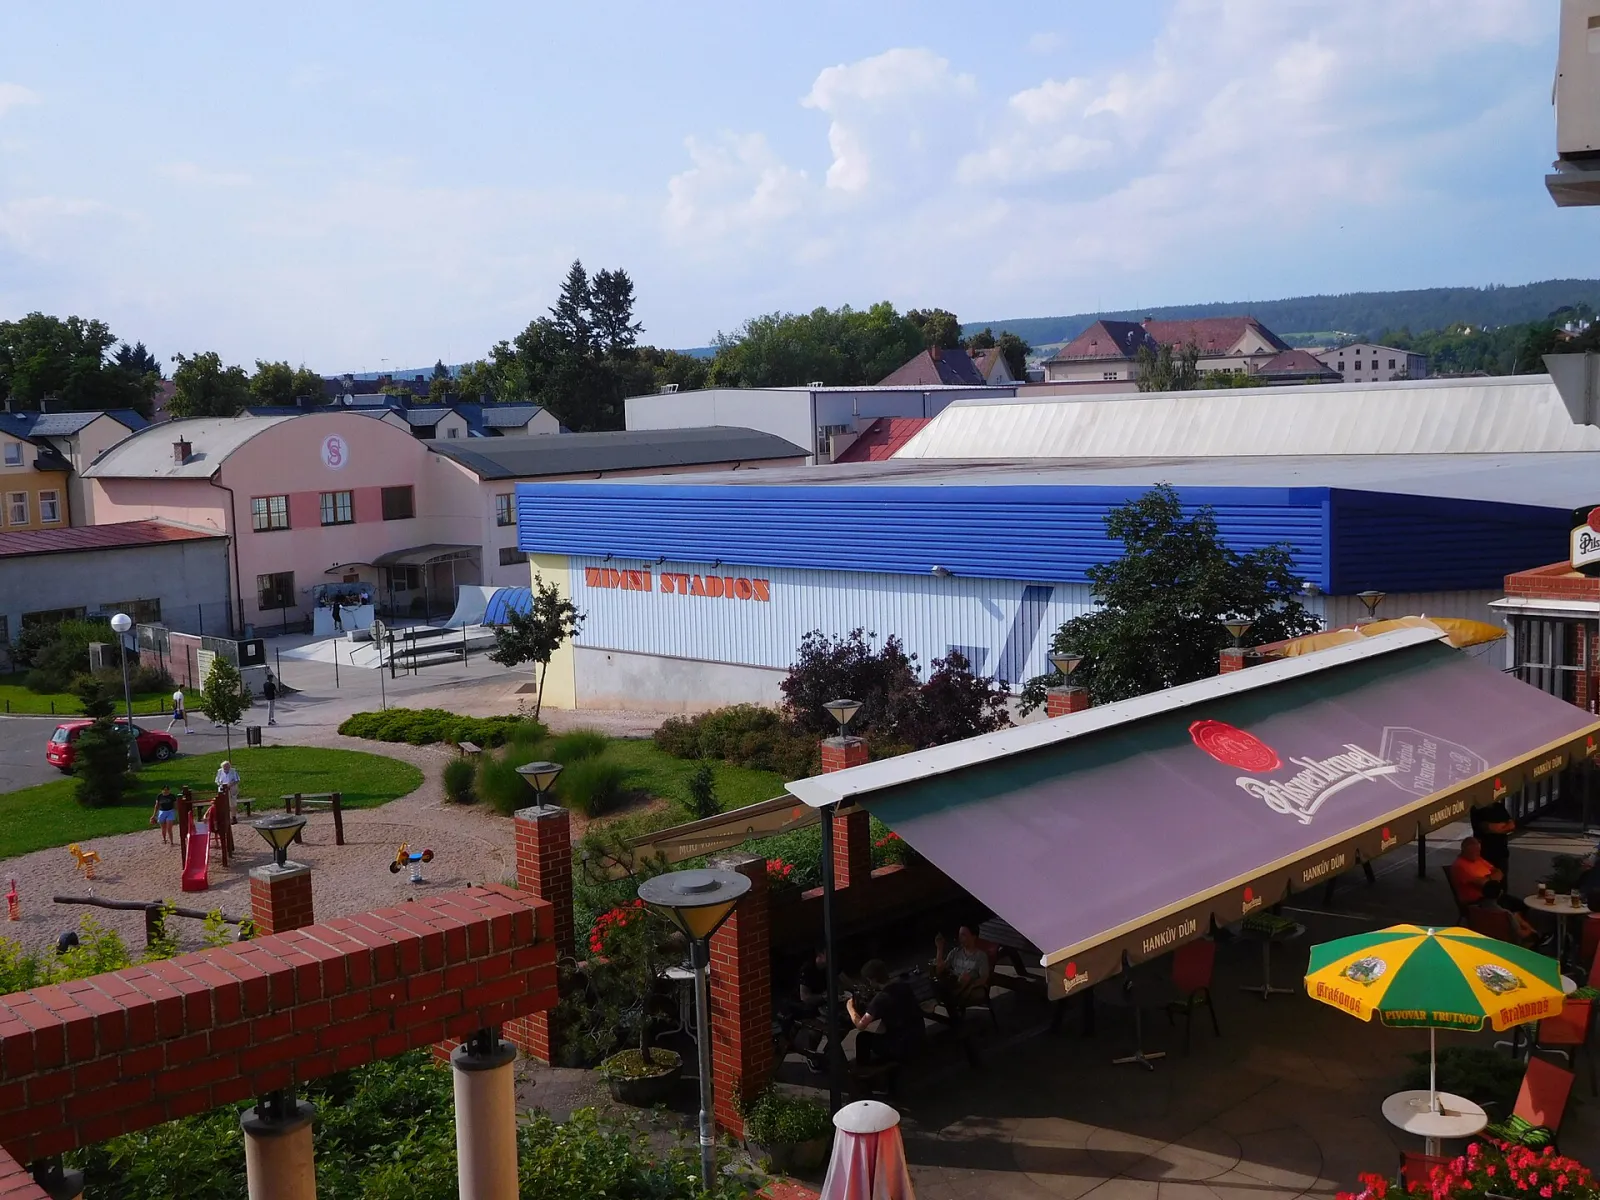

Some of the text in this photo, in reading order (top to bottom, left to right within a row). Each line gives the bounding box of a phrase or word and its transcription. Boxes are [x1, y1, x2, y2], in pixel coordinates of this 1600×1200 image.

[660, 572, 770, 602] STADION
[1414, 738, 1437, 793] Pilsner Bier
[1142, 918, 1197, 954] HANKŮV DŮM
[1385, 1010, 1480, 1025] PIVOVAR TRUTNOV
